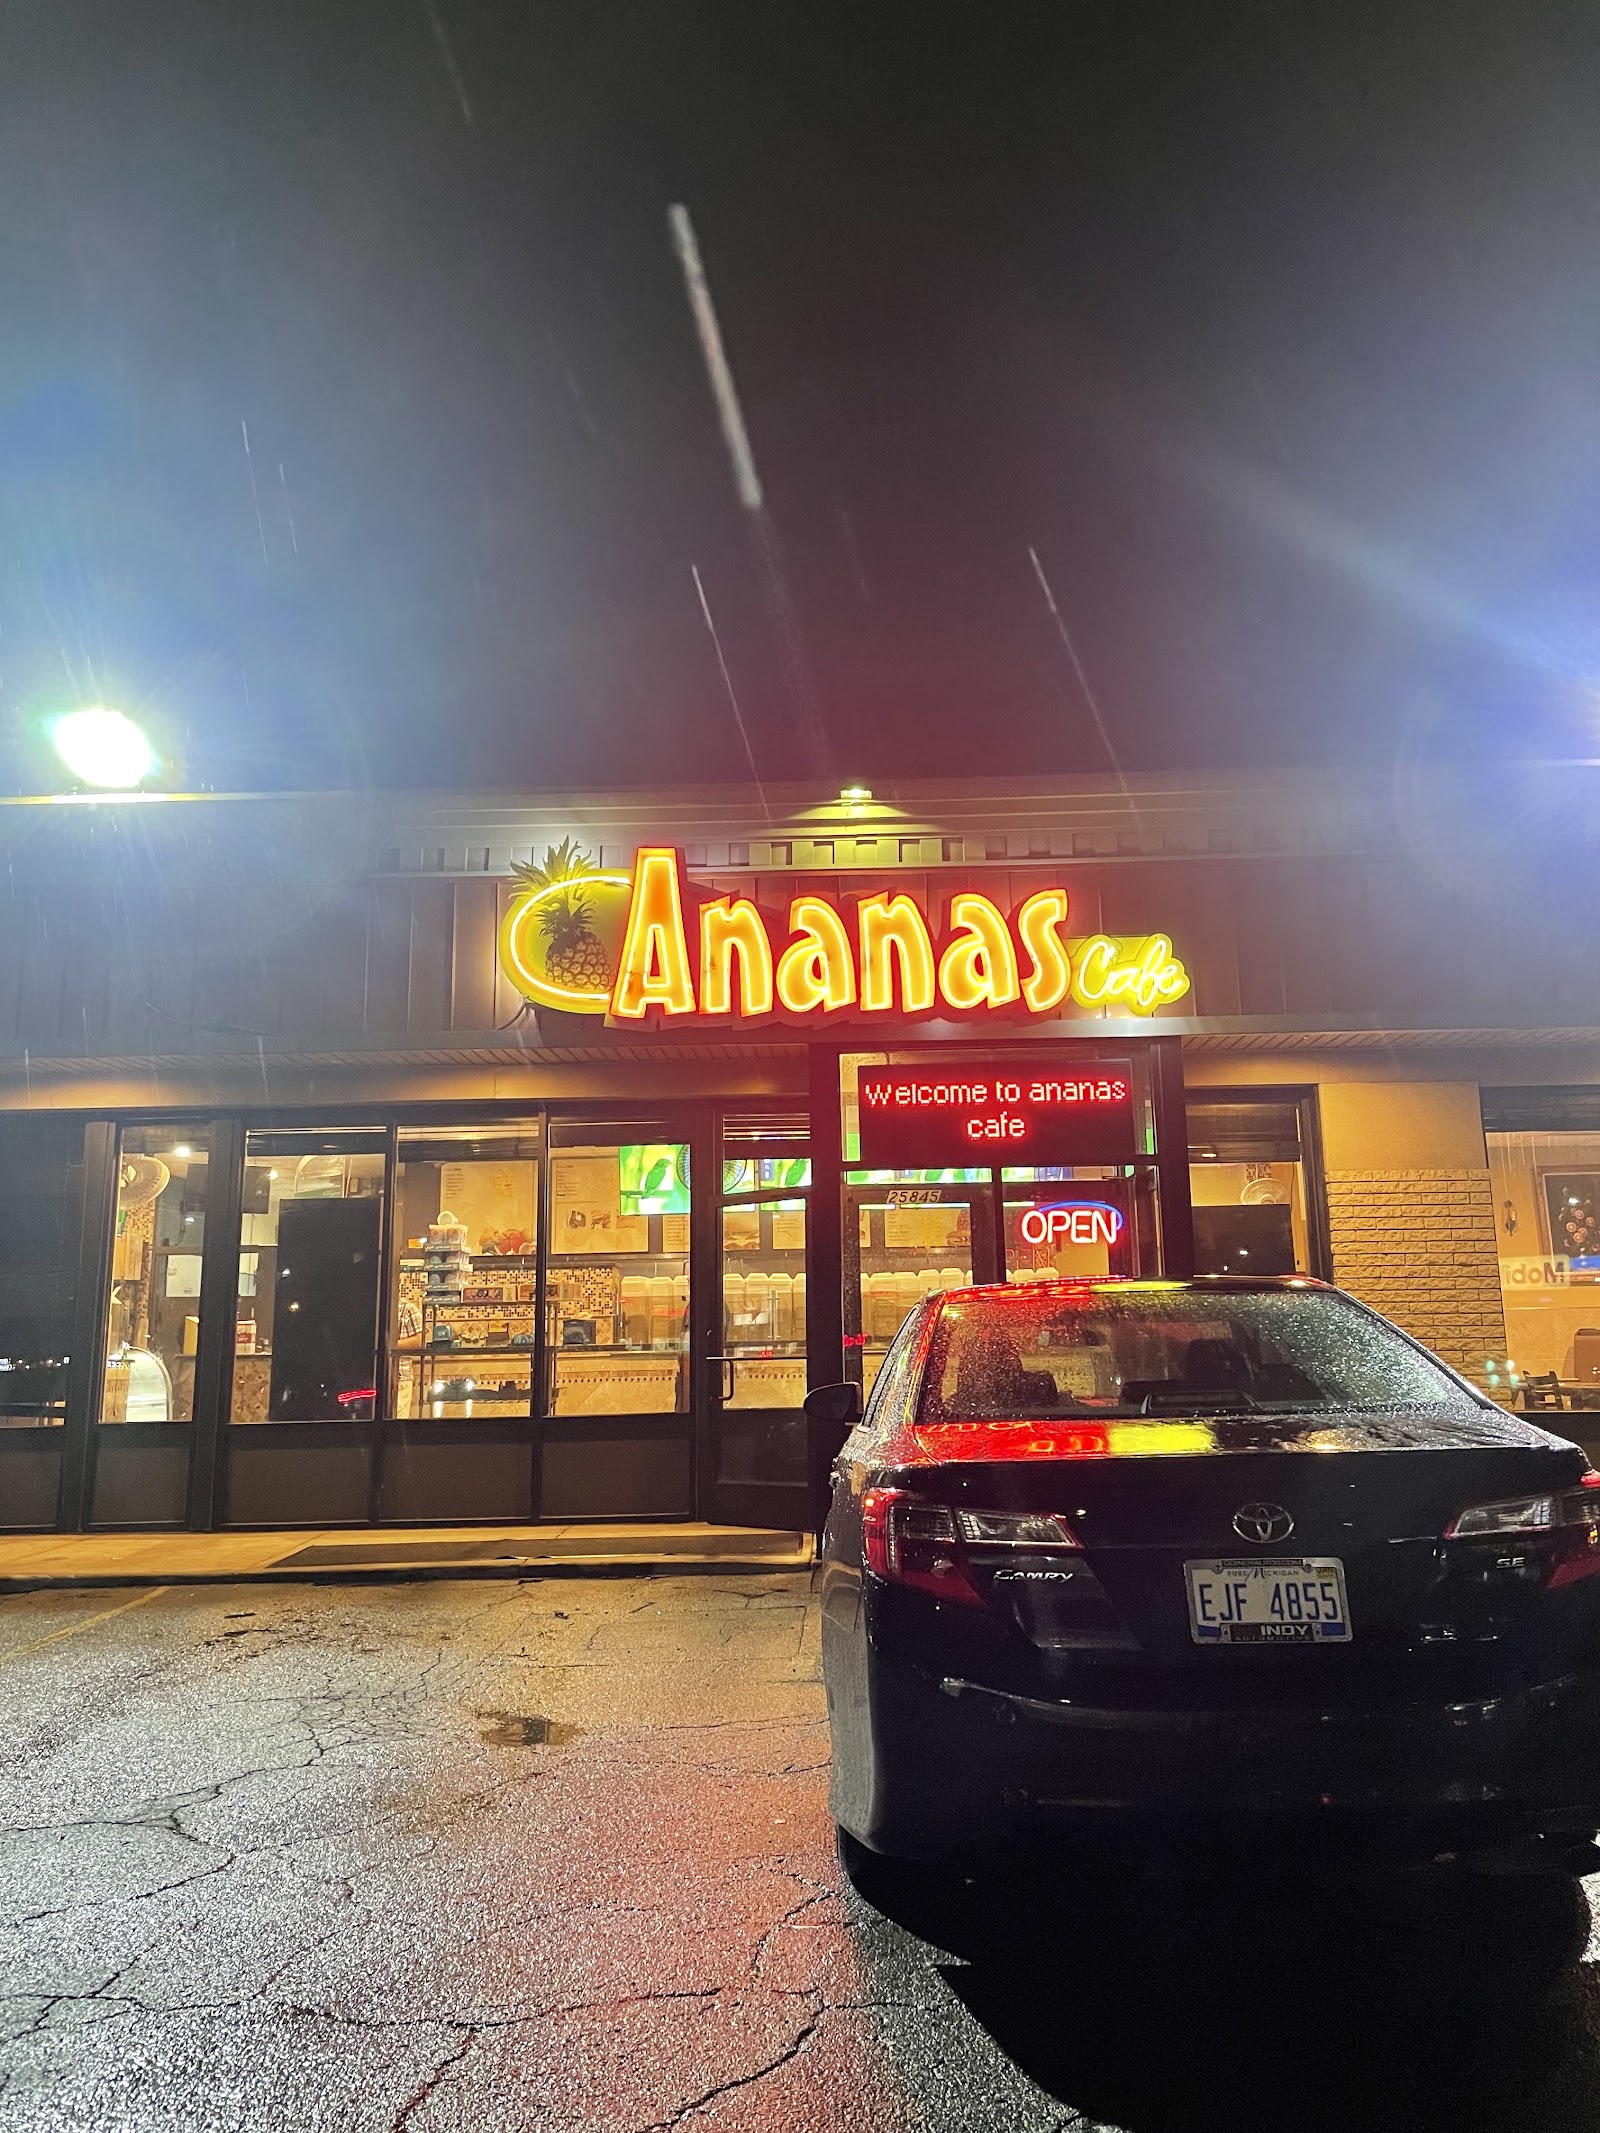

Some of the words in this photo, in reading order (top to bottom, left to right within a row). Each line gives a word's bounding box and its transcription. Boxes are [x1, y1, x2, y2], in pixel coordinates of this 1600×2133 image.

[610, 846, 1068, 1019] Ananas
[864, 1083, 988, 1106] Welcome
[995, 1081, 1021, 1103] to
[1028, 1081, 1126, 1103] ananas
[967, 1111, 1026, 1140] cafe
[889, 1190, 939, 1203] 25845
[1021, 1210, 1118, 1245] OPEN
[1245, 1567, 1299, 1581] MICHIGAN
[1496, 1557, 1525, 1569] SE
[1199, 1583, 1247, 1621] EJF
[1271, 1582, 1338, 1621] 4855
[1261, 1625, 1309, 1636] INDY
